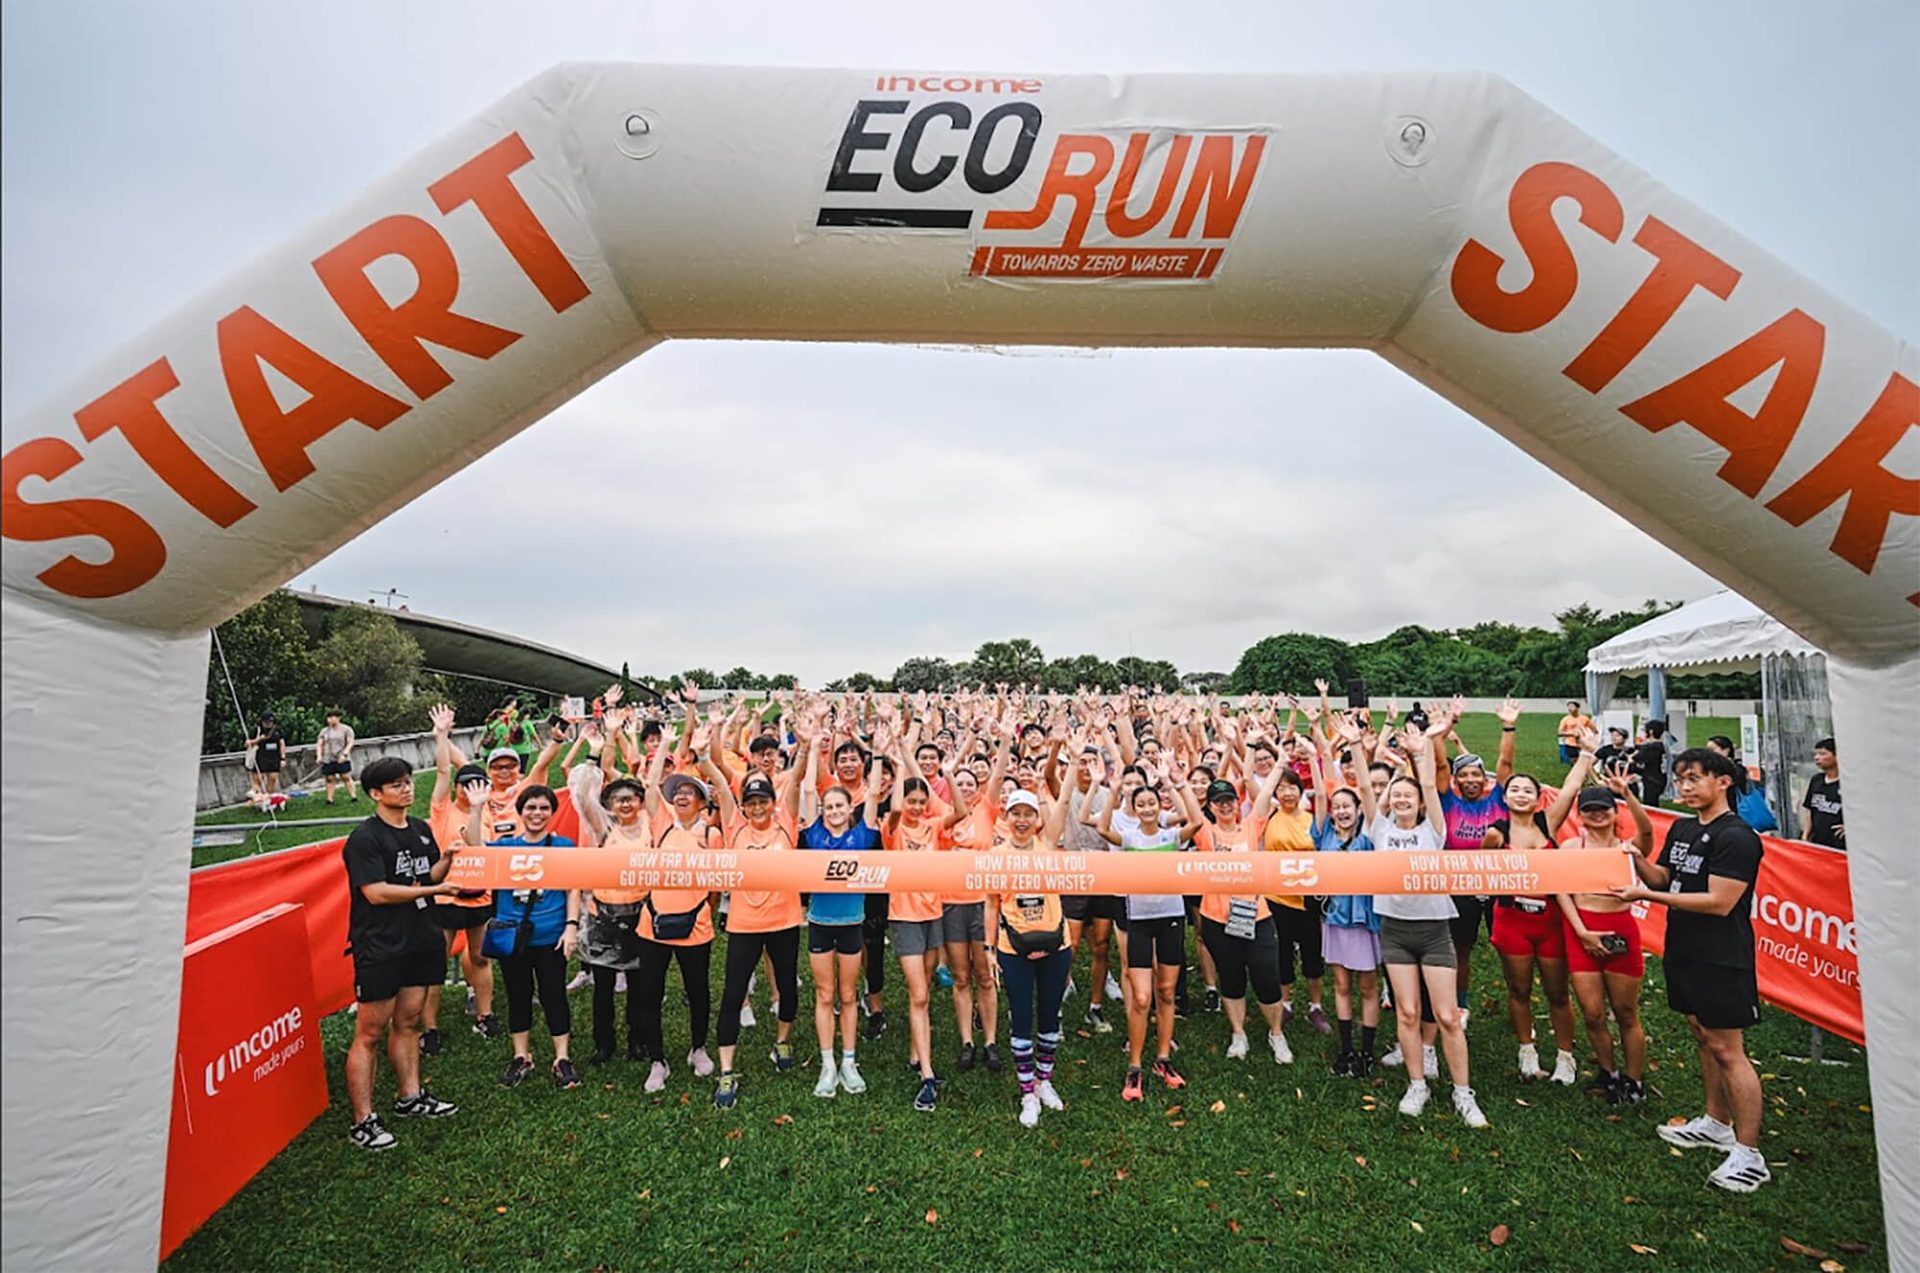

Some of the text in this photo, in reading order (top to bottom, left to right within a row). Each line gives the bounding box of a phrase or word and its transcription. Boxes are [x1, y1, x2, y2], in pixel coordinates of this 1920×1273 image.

[876, 76, 1043, 94] income
[825, 100, 1268, 244] ECO RUN
[1001, 253, 1189, 272] TOWARDS ZERO WASTE
[0, 131, 592, 599] START
[1451, 161, 1920, 609] STAR
[510, 854, 544, 881] 55
[629, 852, 738, 869] HOW FAR WILL YOU
[975, 855, 1087, 872] HOW FAR WILL YOU
[1194, 860, 1253, 873] income
[1409, 854, 1529, 871] HOW FAR WILL YOU
[620, 870, 744, 888] GO FOR ZERO WASTE?
[826, 860, 891, 884] ECO RUN
[965, 873, 1096, 890] GO FOR ZERO WASTE?
[1279, 858, 1319, 887] 55
[1403, 873, 1540, 891] GO FOR ZERO WASTE?
[1758, 936, 1809, 969] made
[229, 1006, 302, 1073] income
[253, 1035, 305, 1082] made yours
